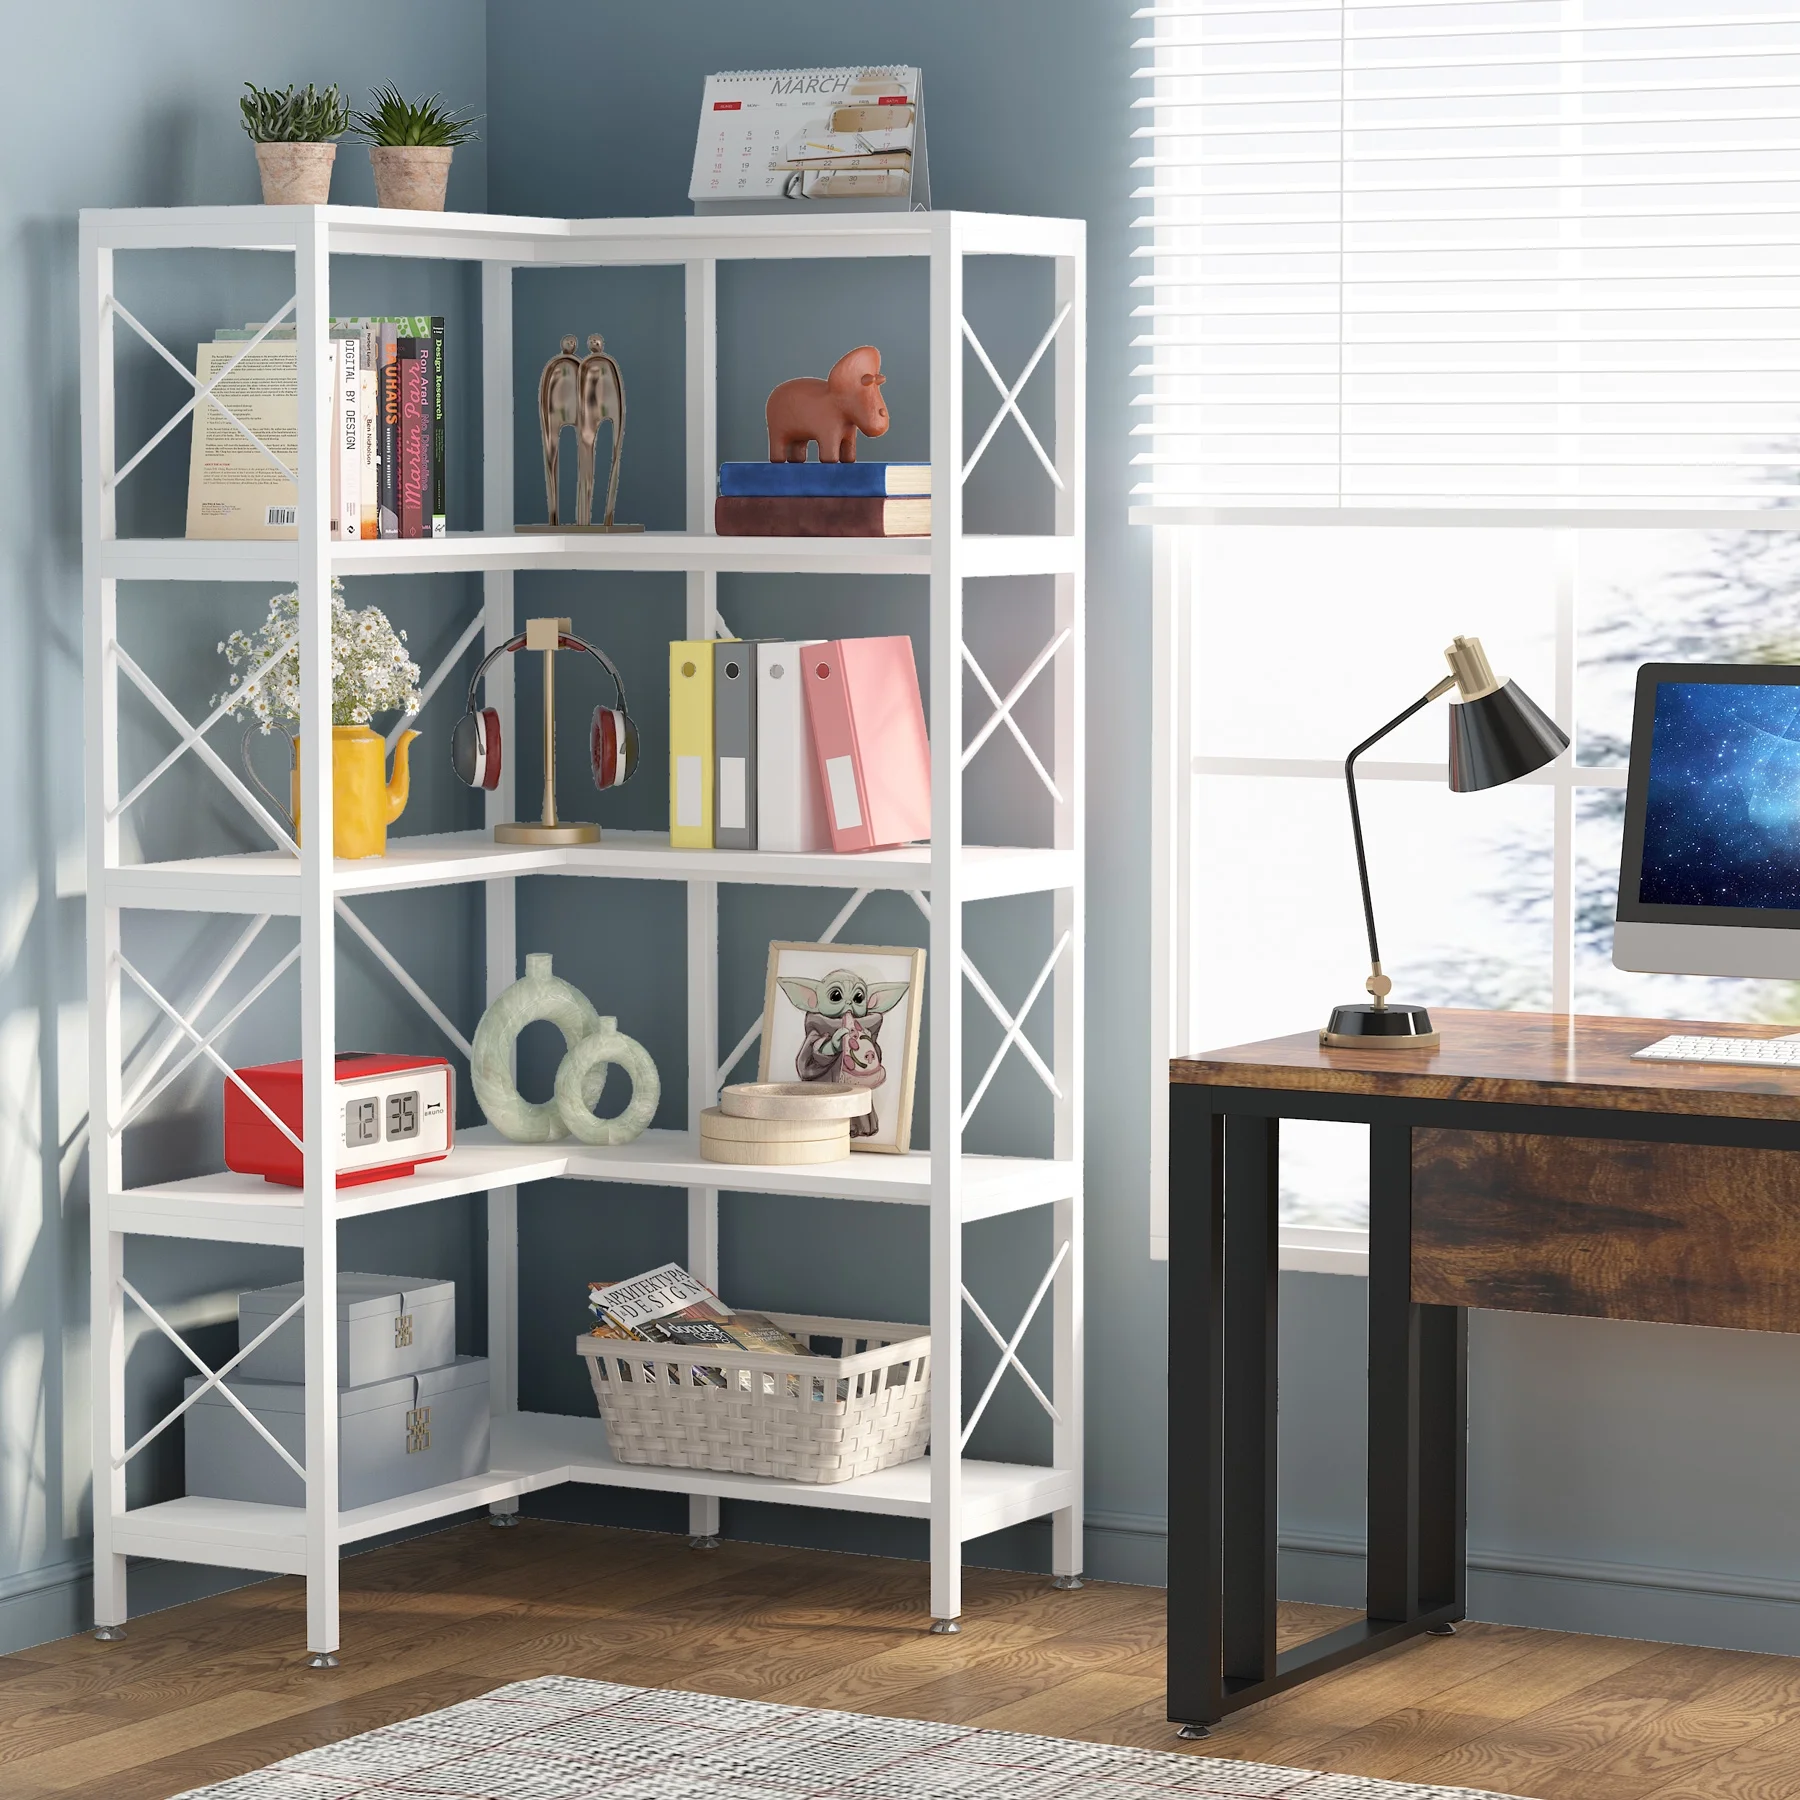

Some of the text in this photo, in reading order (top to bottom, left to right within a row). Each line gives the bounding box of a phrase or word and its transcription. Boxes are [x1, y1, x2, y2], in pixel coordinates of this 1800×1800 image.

[771, 78, 849, 94] MARCH
[420, 349, 429, 374] Ron
[435, 339, 443, 372] Design
[345, 340, 356, 450] DIGITAL BY DESIGN
[385, 343, 398, 425] BAUHAUS
[404, 362, 420, 418] Parr
[420, 377, 429, 406] Arad
[435, 375, 443, 420] Research
[421, 413, 430, 431] No
[404, 424, 421, 505] Martin
[358, 1096, 414, 1139] 12 35
[603, 1268, 690, 1307] АРХИТЕКТУРА
[620, 1280, 702, 1318] DESIGN
[667, 1321, 720, 1335] domus
